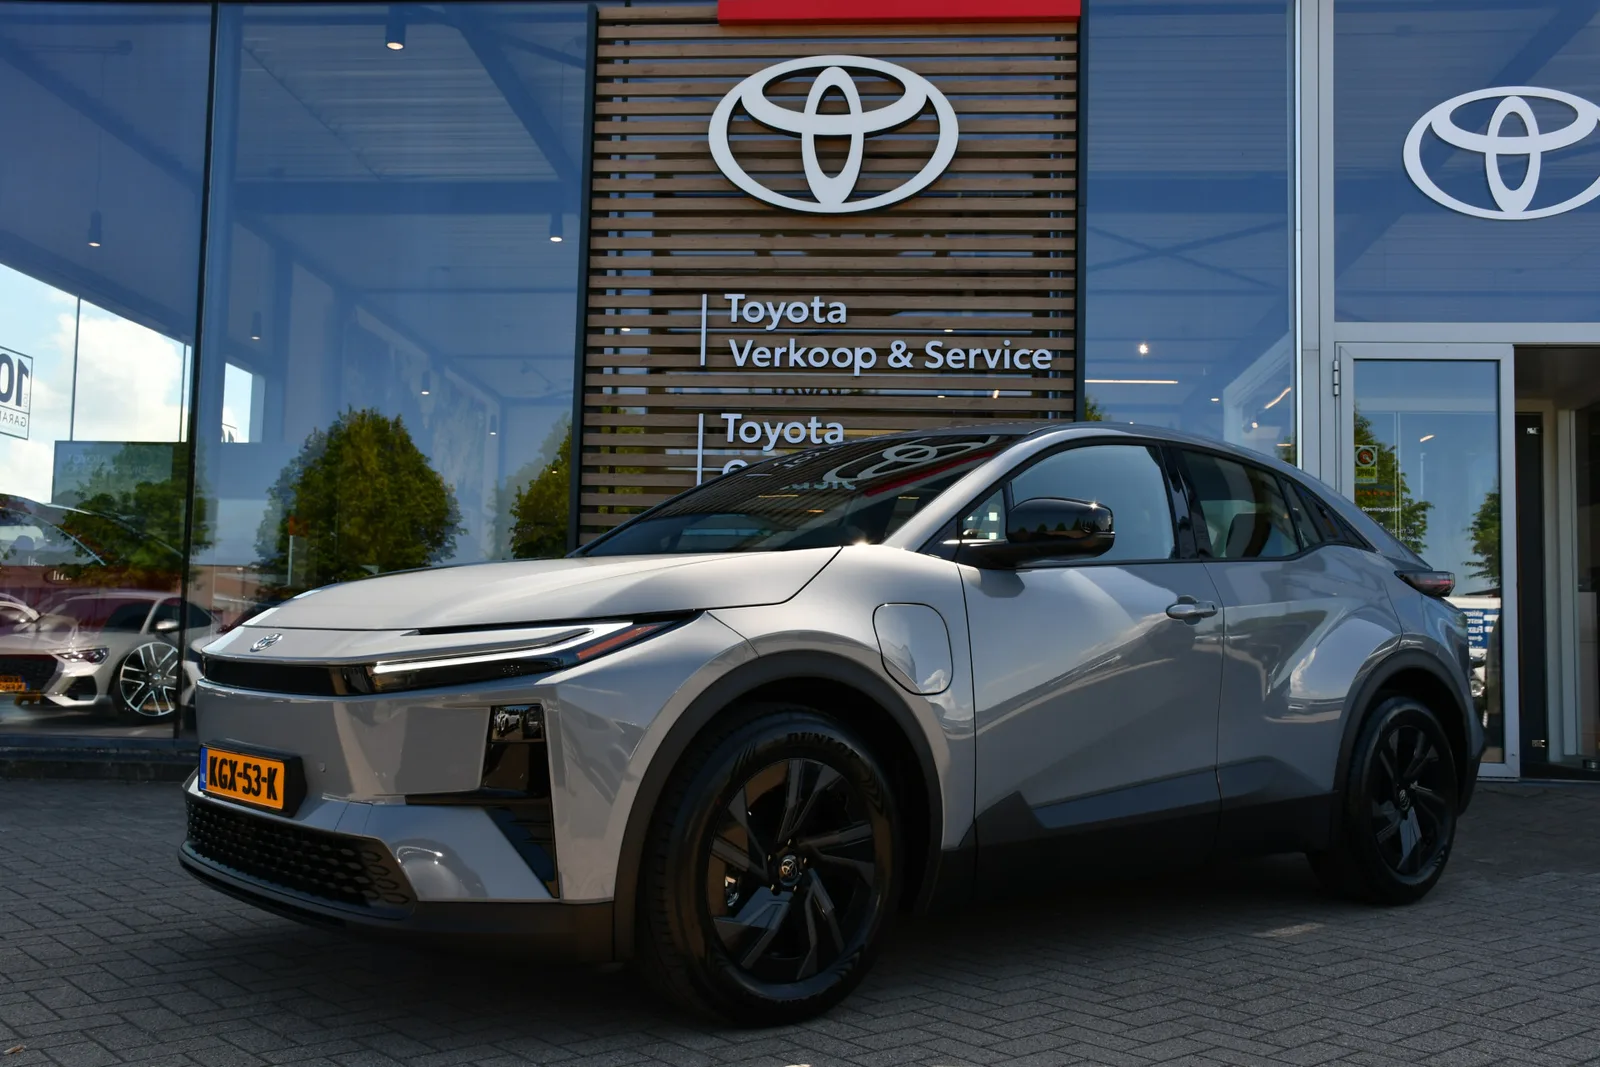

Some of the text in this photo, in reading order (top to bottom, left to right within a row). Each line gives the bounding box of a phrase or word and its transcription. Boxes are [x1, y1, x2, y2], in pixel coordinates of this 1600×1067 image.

[724, 293, 847, 331] Toyota
[729, 338, 1053, 376] Verkoop & Service
[721, 413, 845, 453] Toyota
[209, 756, 278, 800] KGX-53-K
